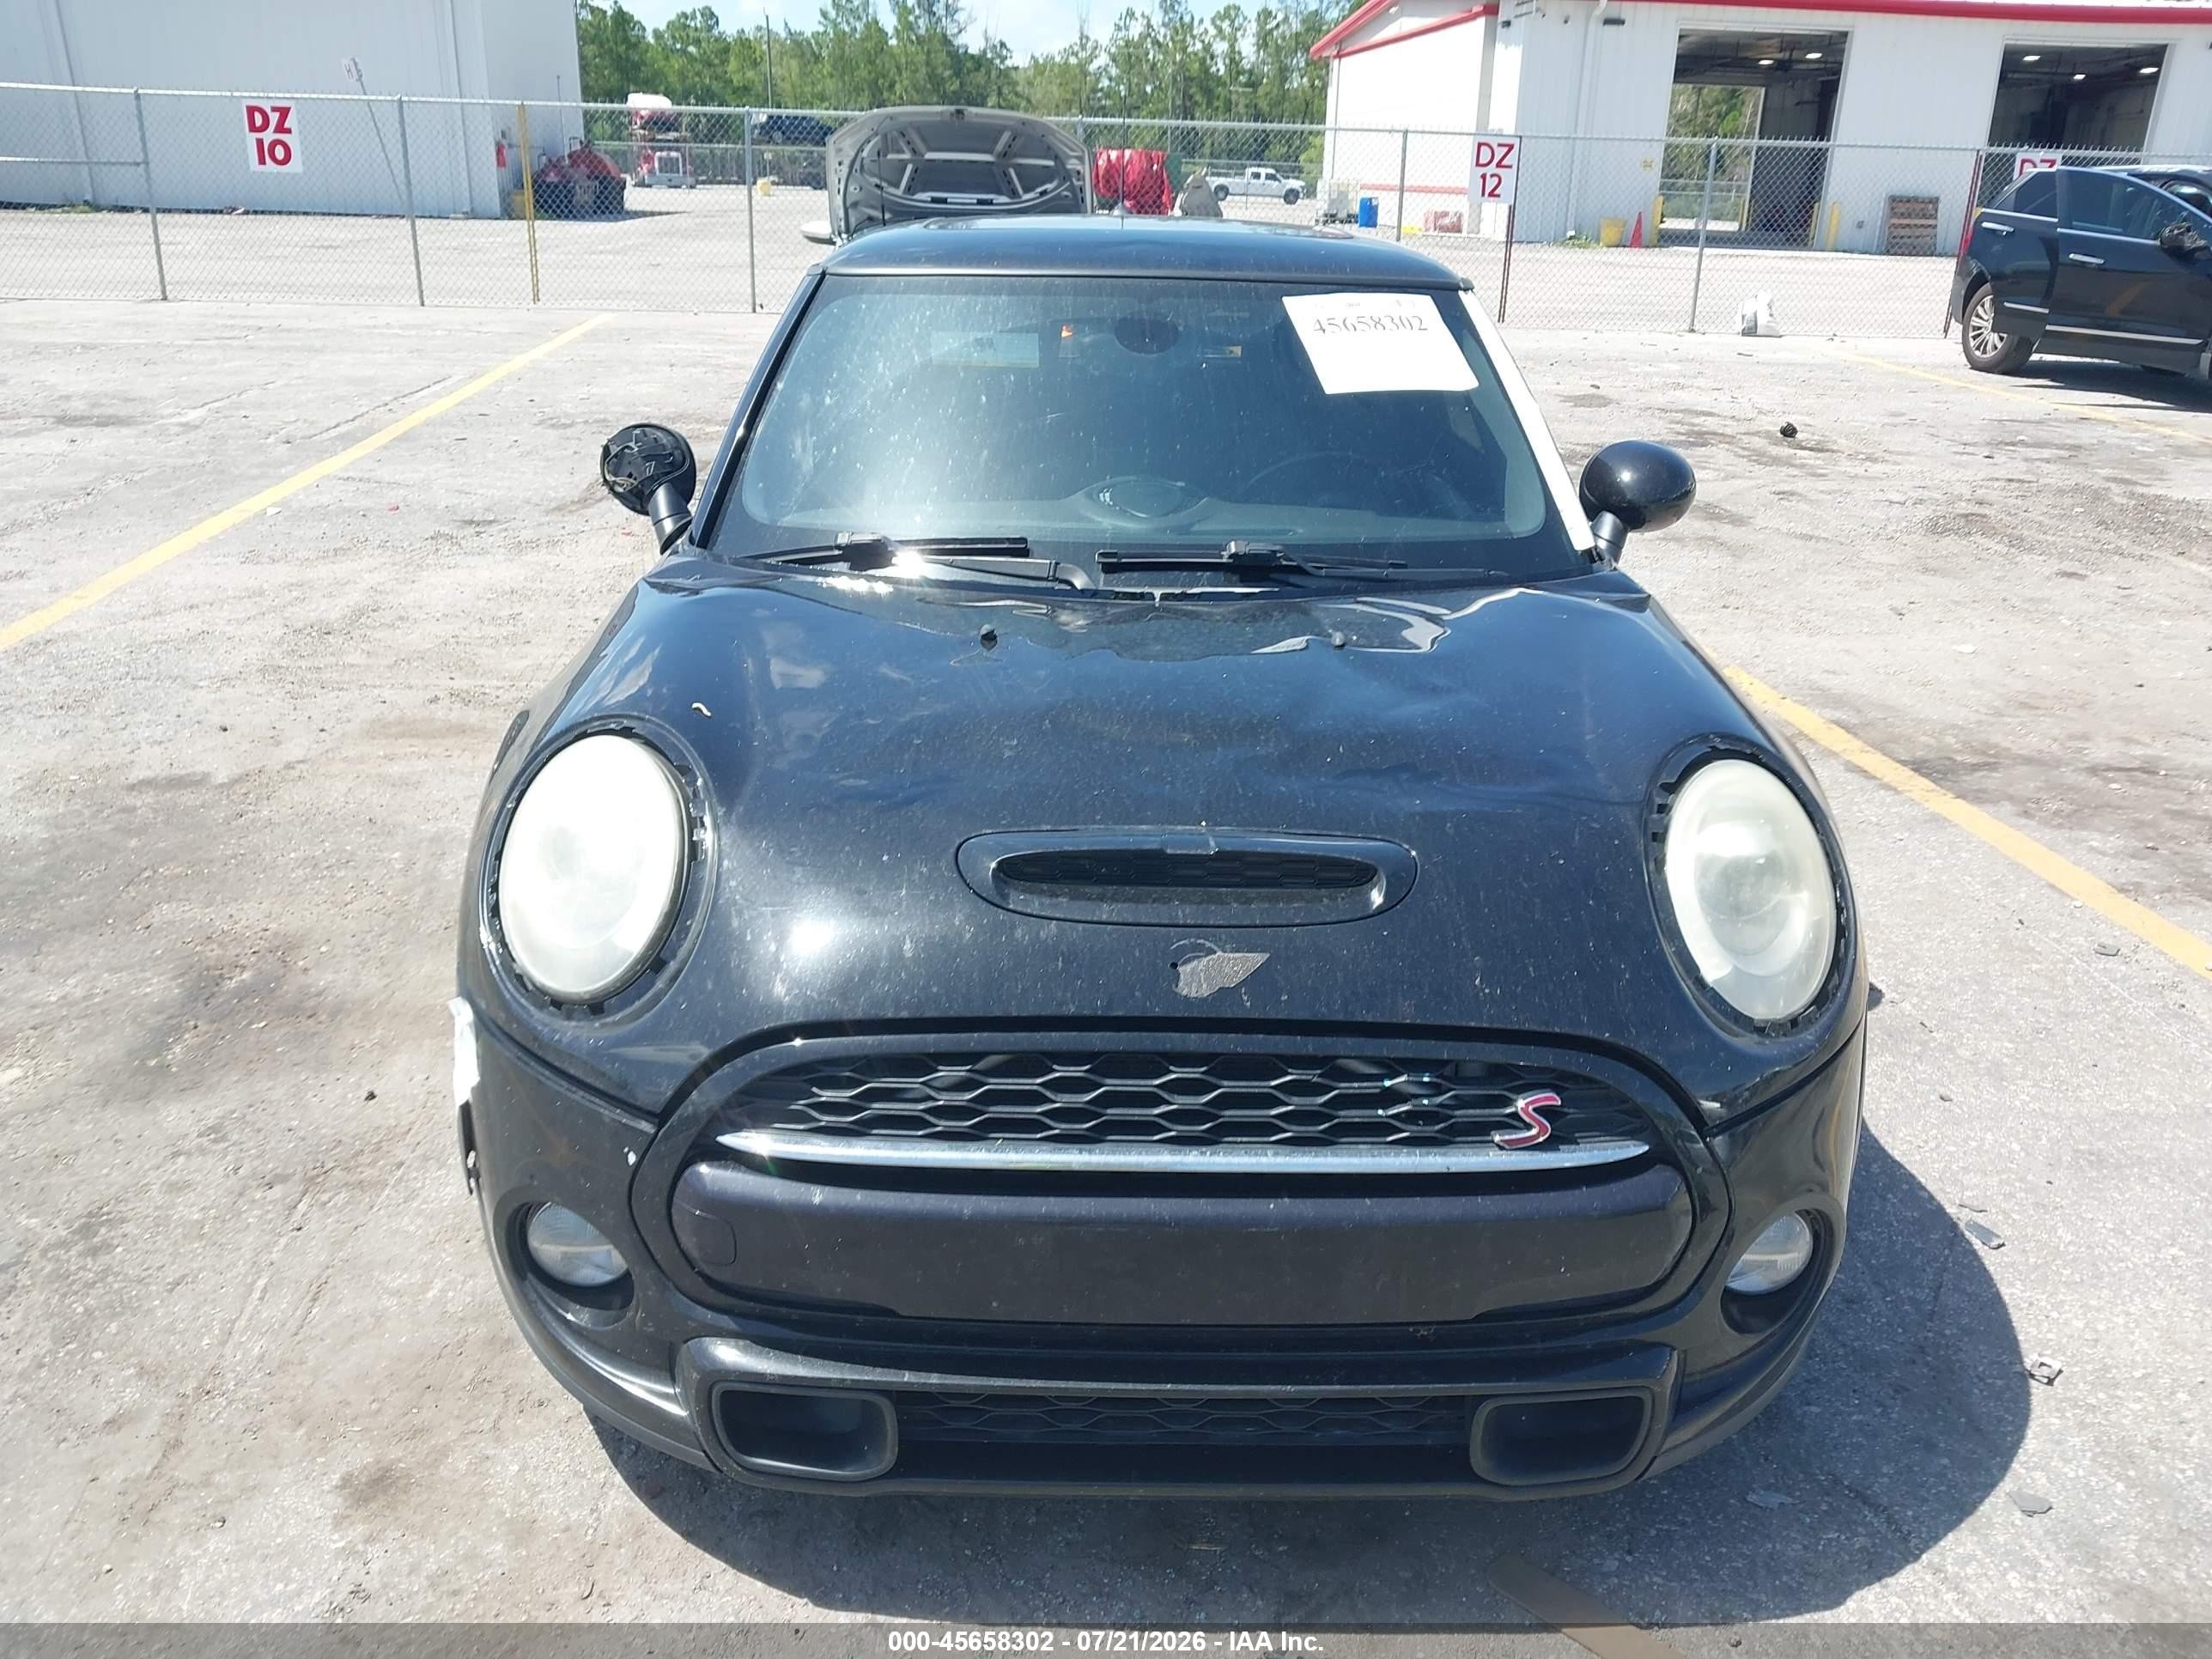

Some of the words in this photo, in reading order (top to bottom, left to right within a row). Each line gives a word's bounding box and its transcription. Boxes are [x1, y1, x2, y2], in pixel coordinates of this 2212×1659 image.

[246, 105, 292, 134] DZ
[1475, 142, 1515, 168] DZ
[1480, 173, 1502, 198] 12
[1491, 1089, 1561, 1150] S
